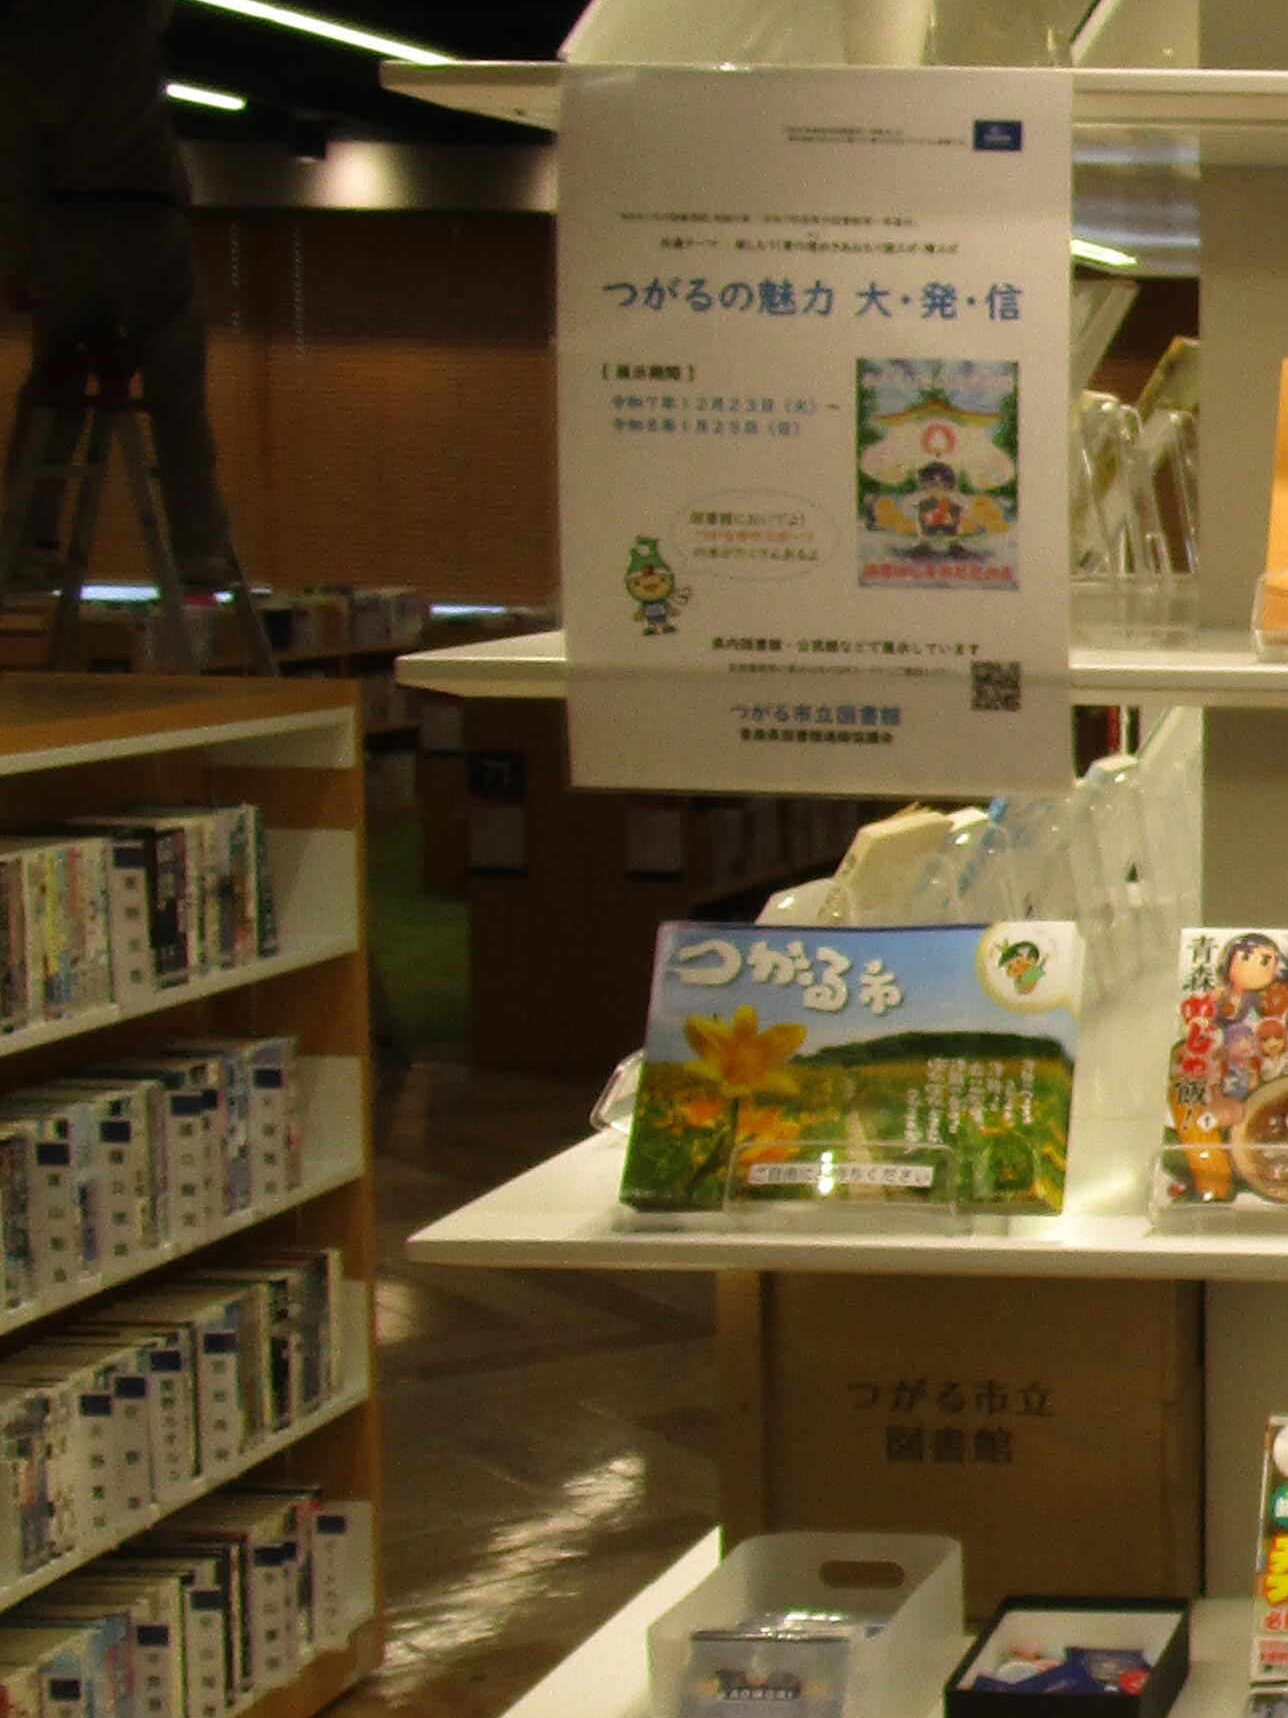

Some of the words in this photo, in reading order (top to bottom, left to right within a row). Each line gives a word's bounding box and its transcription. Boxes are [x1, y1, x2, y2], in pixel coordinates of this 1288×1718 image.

[602, 276, 835, 317] つがるの魅力
[854, 280, 1023, 321] 大・発・信
[670, 937, 903, 1017] つがる市
